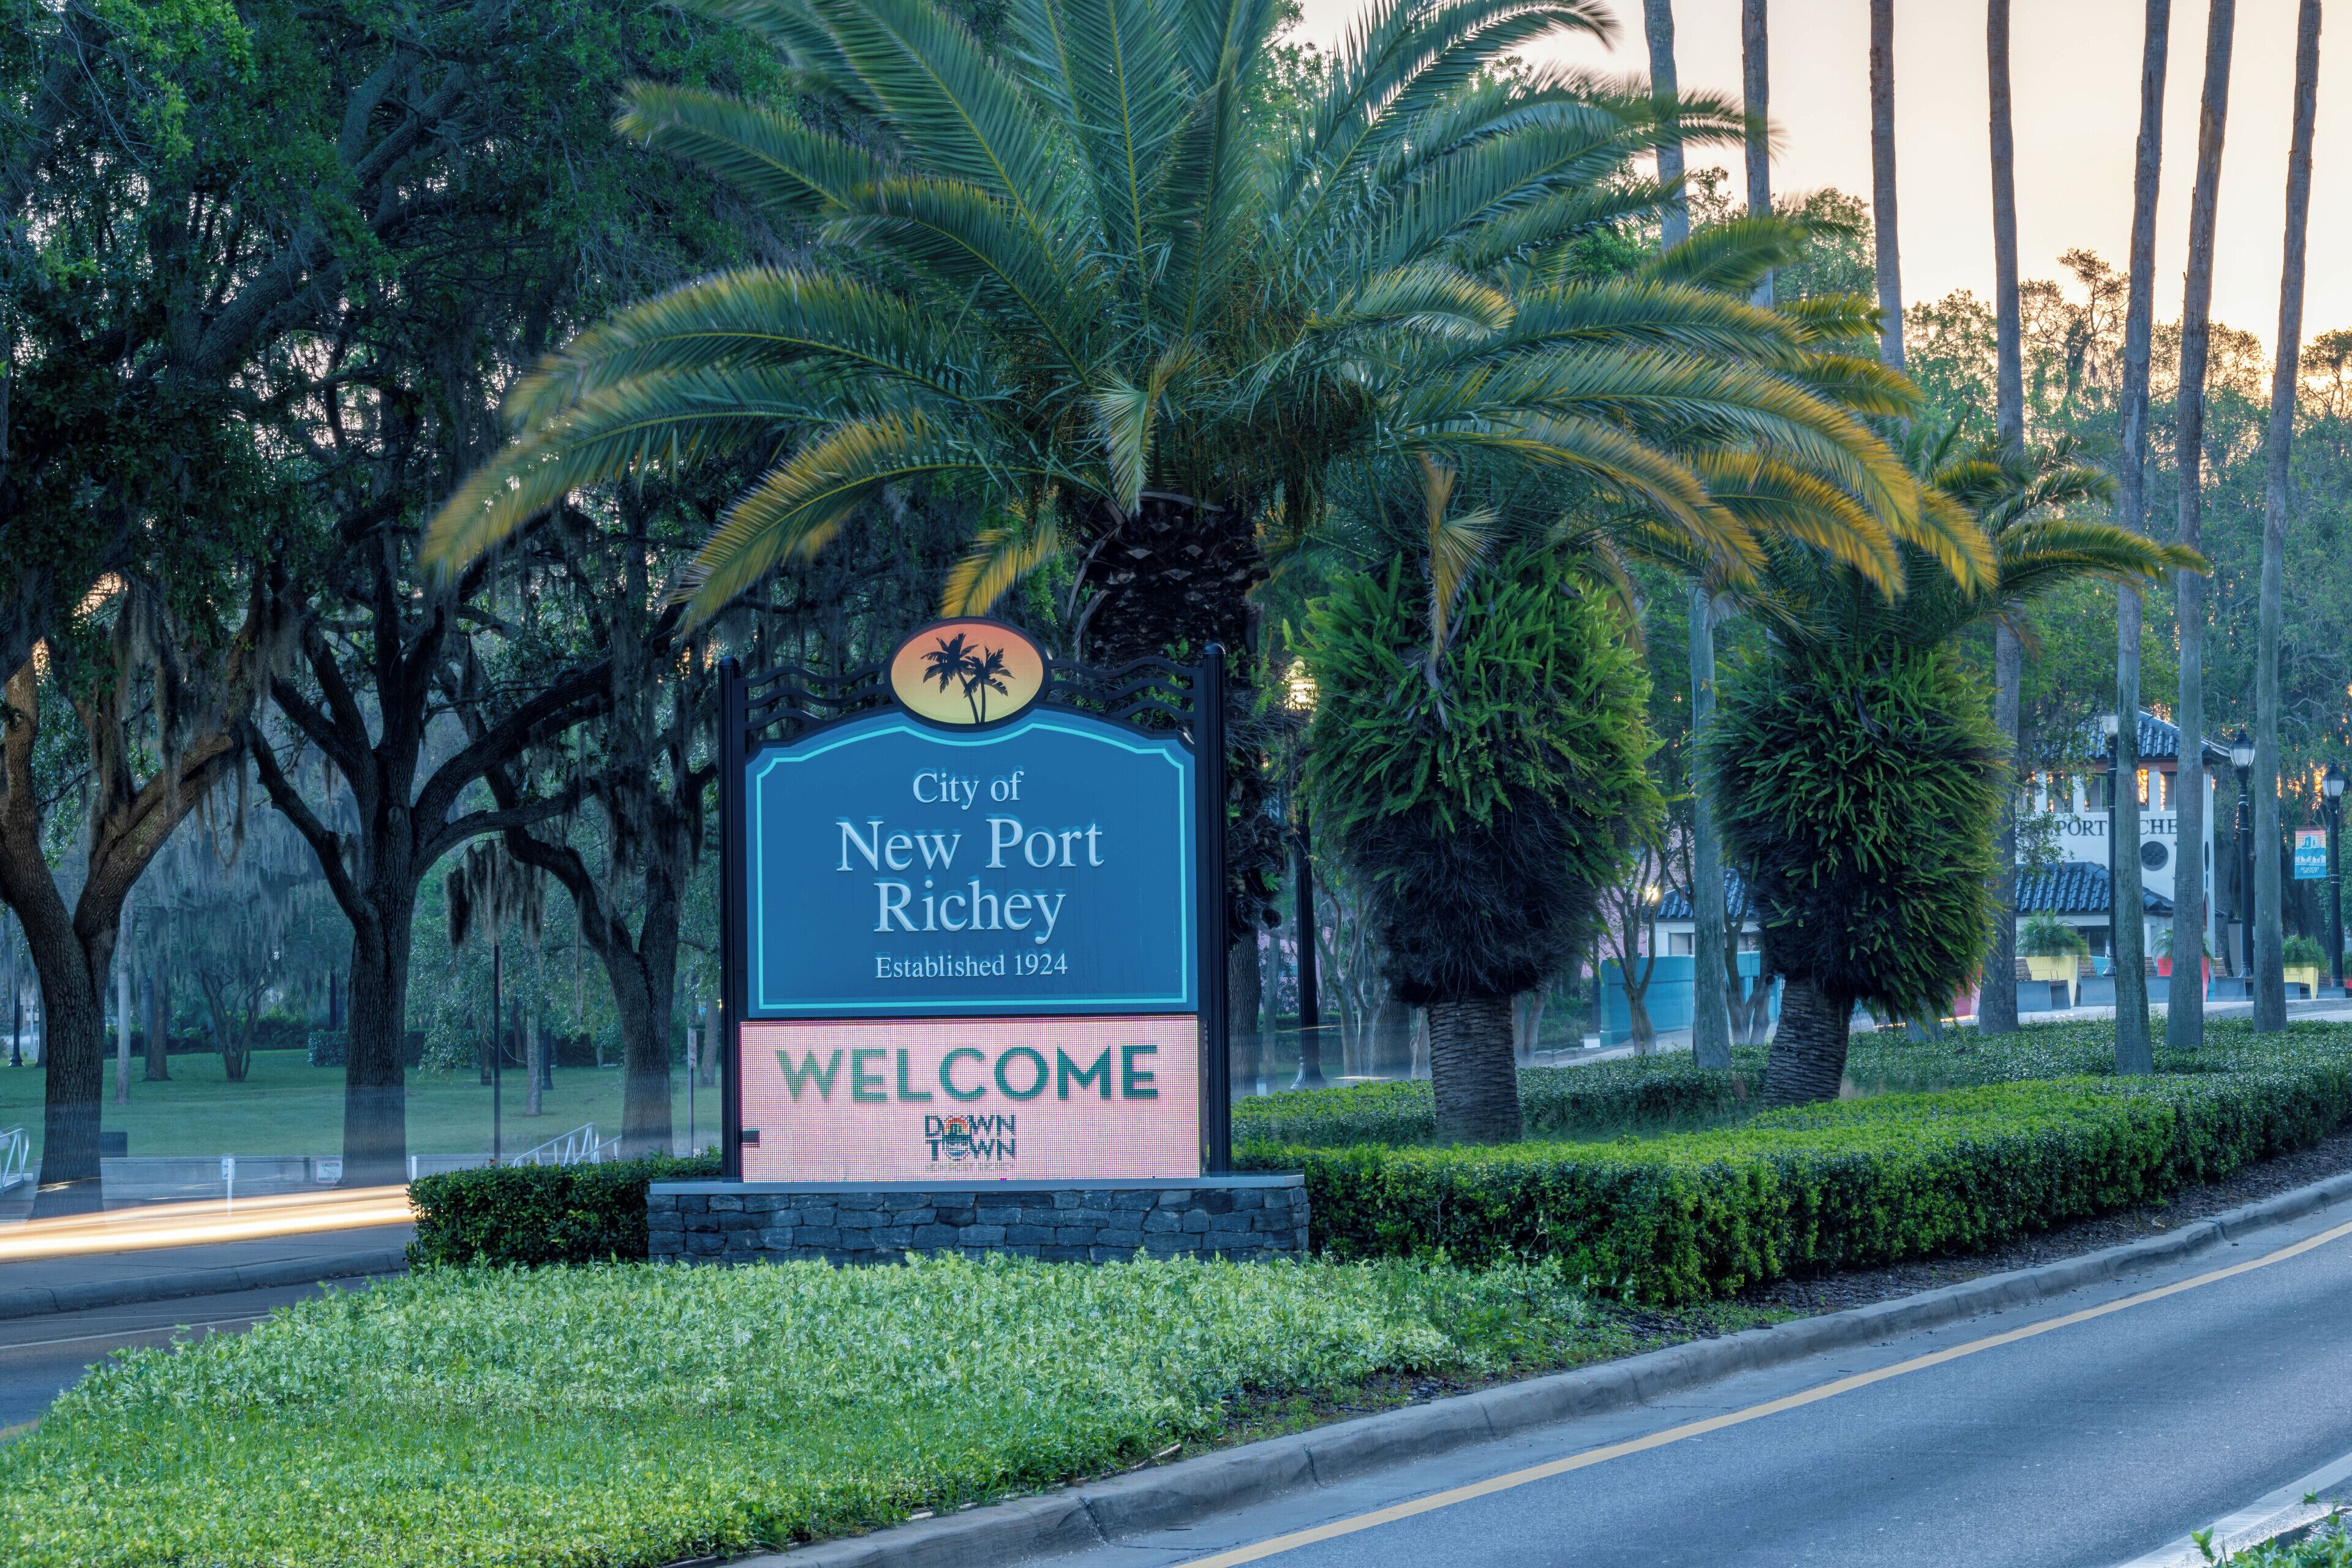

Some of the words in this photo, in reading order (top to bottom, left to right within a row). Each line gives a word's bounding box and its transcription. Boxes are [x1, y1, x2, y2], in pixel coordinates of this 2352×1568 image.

[913, 772, 980, 810] City
[990, 771, 1025, 802] of
[836, 821, 962, 871] New
[986, 818, 1104, 868] Port
[2055, 820, 2108, 836] PORT
[2140, 818, 2177, 835] CHE
[873, 880, 1066, 944] Richey
[875, 954, 1005, 979] Established
[1015, 954, 1068, 976] 1924
[775, 1044, 1158, 1102] WELCOME
